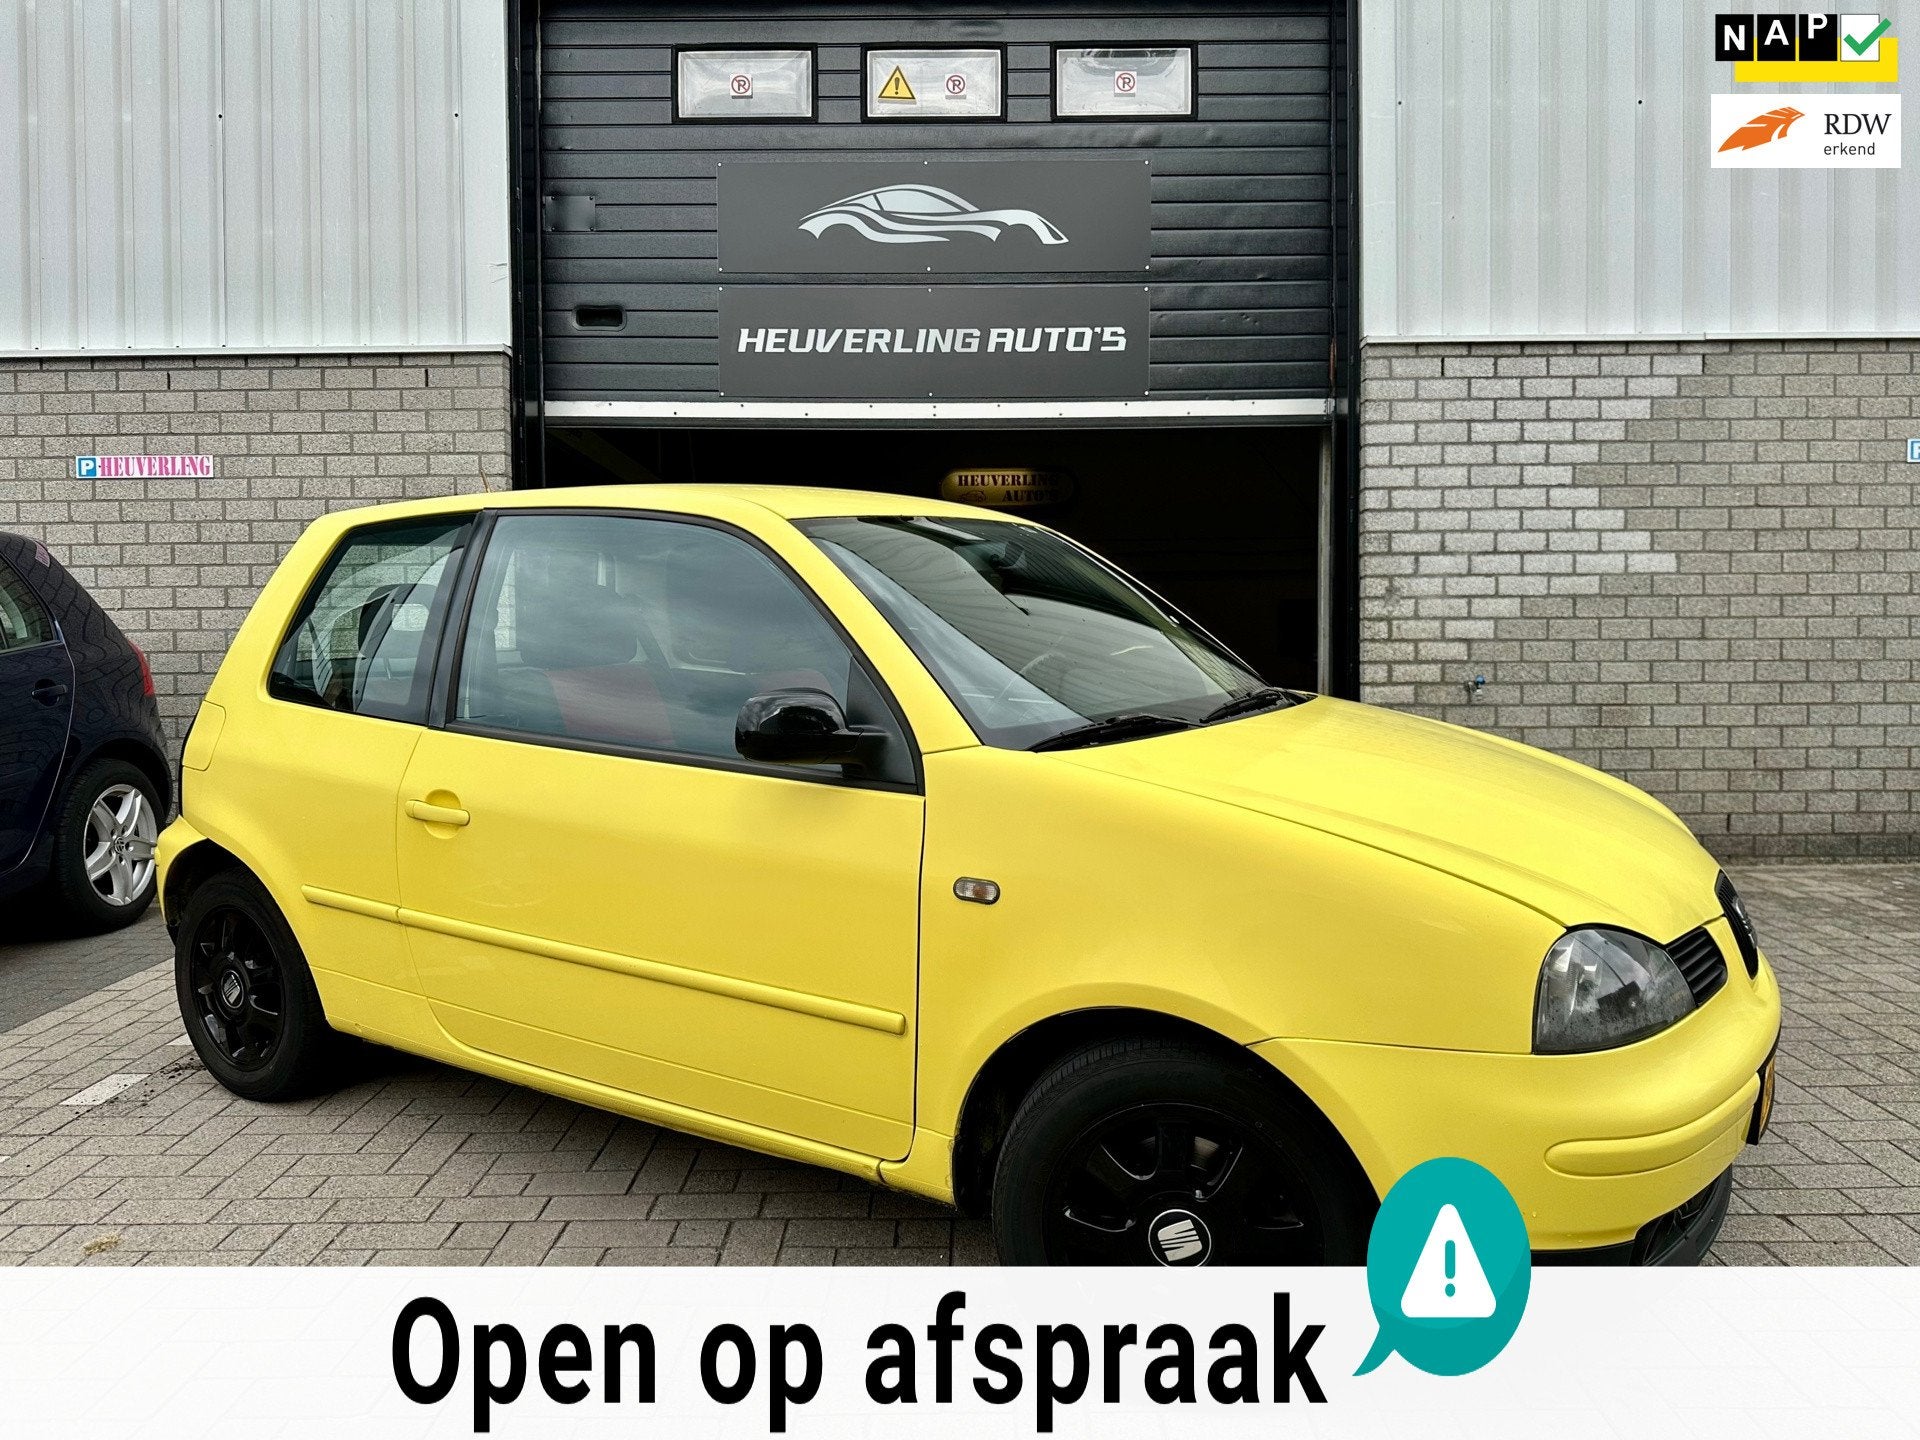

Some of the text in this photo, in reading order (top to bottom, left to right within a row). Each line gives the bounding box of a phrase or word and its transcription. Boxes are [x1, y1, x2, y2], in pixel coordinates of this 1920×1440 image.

[737, 326, 1127, 354] HEUVERLING AUTO'S
[80, 456, 211, 477] P HEUVERLING
